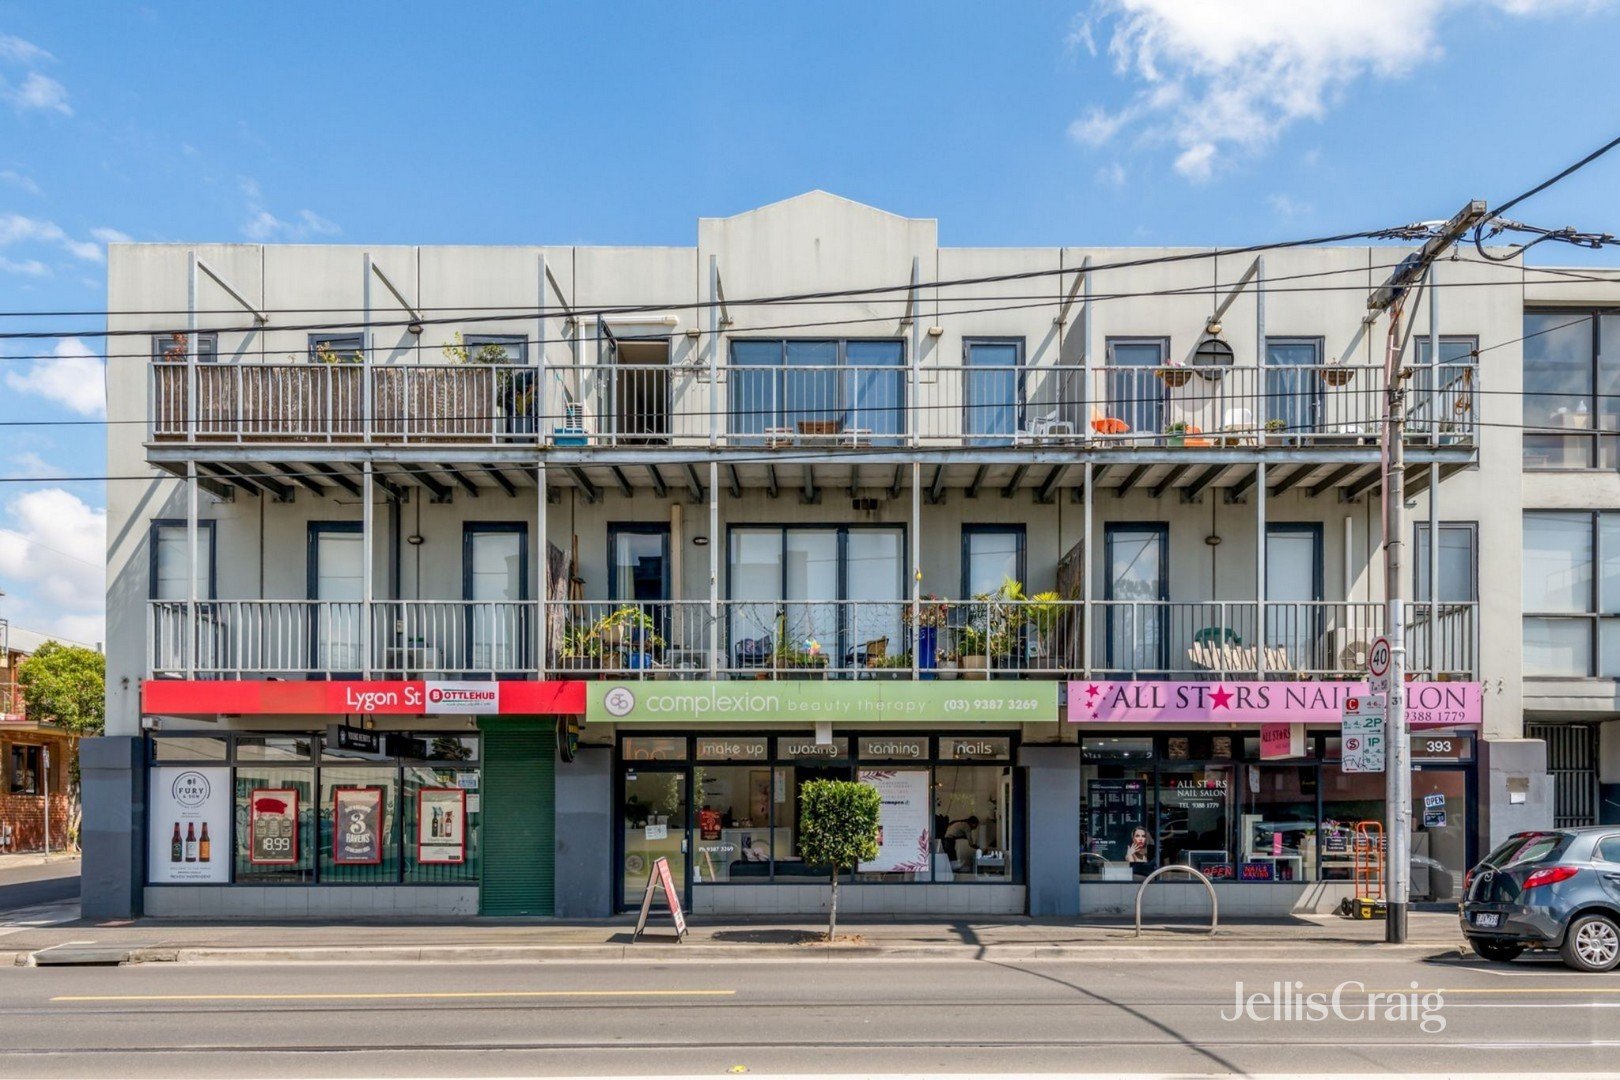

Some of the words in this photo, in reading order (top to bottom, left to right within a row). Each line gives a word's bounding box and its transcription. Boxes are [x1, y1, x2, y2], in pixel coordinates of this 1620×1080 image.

[1372, 648, 1387, 666] 40
[346, 686, 397, 711] Lygon
[404, 686, 422, 706] St
[429, 688, 495, 704] BOTTLEHUB
[646, 685, 779, 717] complexion
[788, 699, 850, 712] beauty
[857, 699, 926, 712] therapy
[1110, 685, 1165, 709] ALL
[944, 699, 970, 712] (03)
[974, 699, 1003, 710] 9387
[1008, 699, 1038, 710] 3269
[1438, 711, 1466, 721] 1779
[957, 742, 992, 755] nails
[1368, 737, 1380, 747] 1P
[1426, 741, 1452, 752] 393
[703, 741, 740, 755] make
[746, 743, 763, 757] up
[788, 743, 837, 757] waxing
[868, 742, 920, 758] tanning
[1177, 780, 1195, 788] ALL
[1177, 789, 1197, 797] NAIL
[1200, 789, 1227, 797] SALON
[1426, 796, 1444, 806] OPEN
[350, 812, 366, 834] 3
[345, 832, 370, 843] RAVENS
[1203, 865, 1231, 877] OPEN
